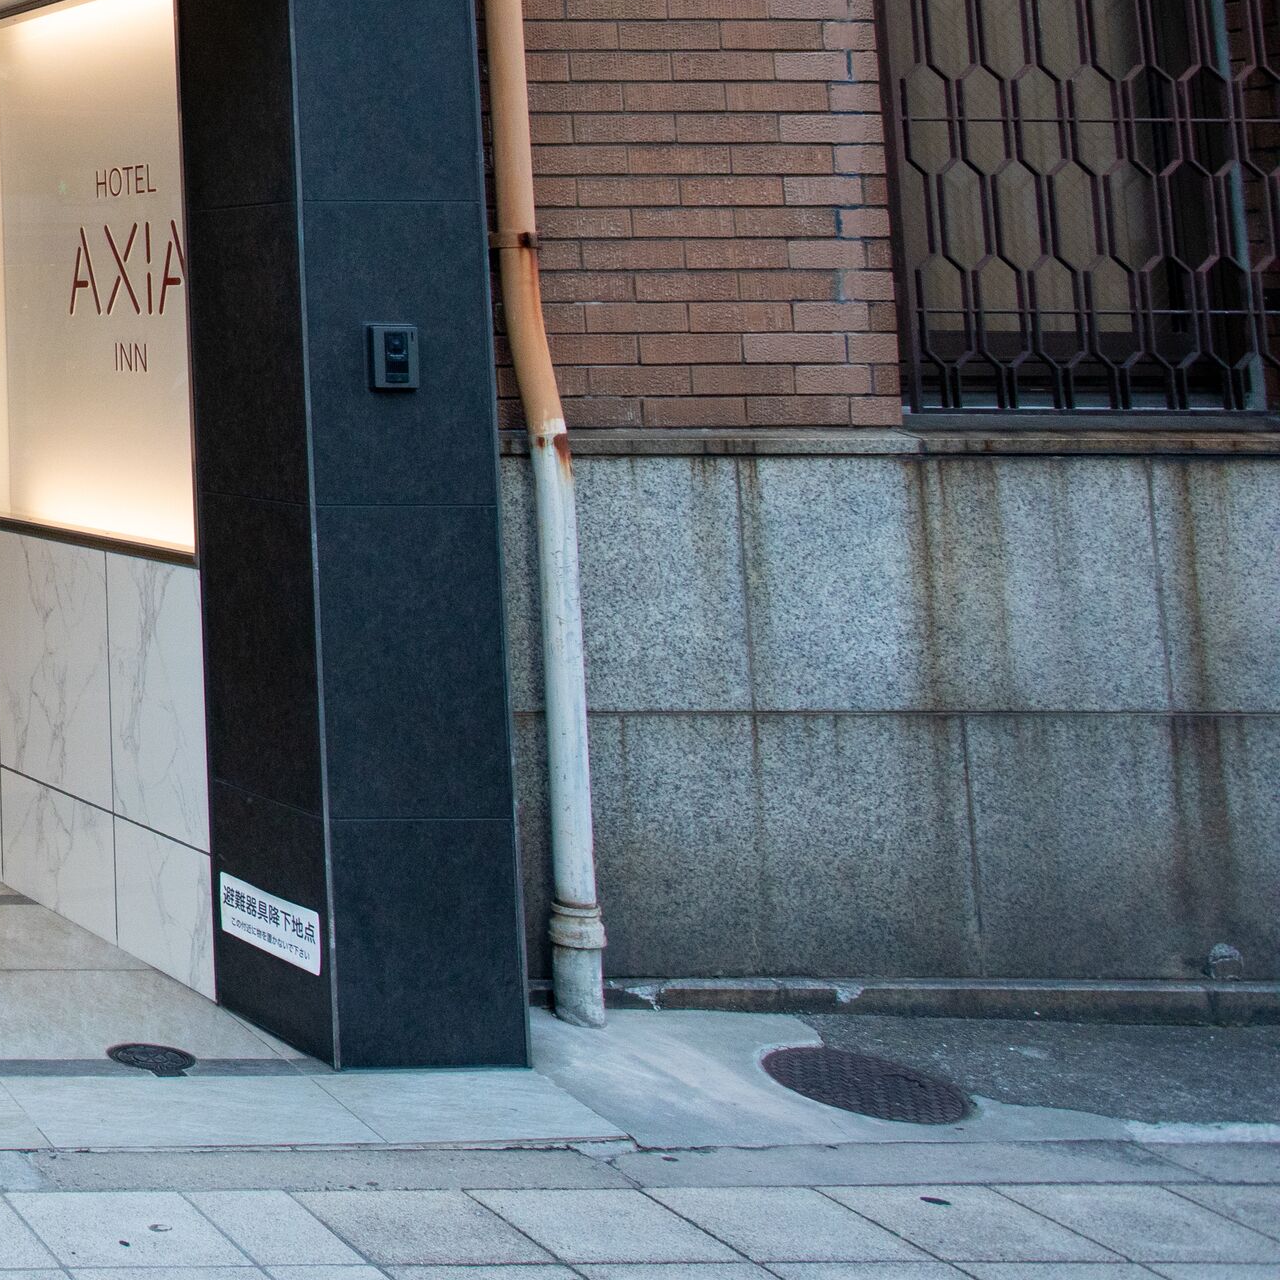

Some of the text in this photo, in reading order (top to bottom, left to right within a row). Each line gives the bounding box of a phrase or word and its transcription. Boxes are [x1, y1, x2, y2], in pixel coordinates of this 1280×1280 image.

[95, 163, 158, 199] HOTEL
[69, 219, 185, 316] AXIA
[114, 342, 148, 373] INN
[223, 885, 316, 945] 避難器具降下地点
